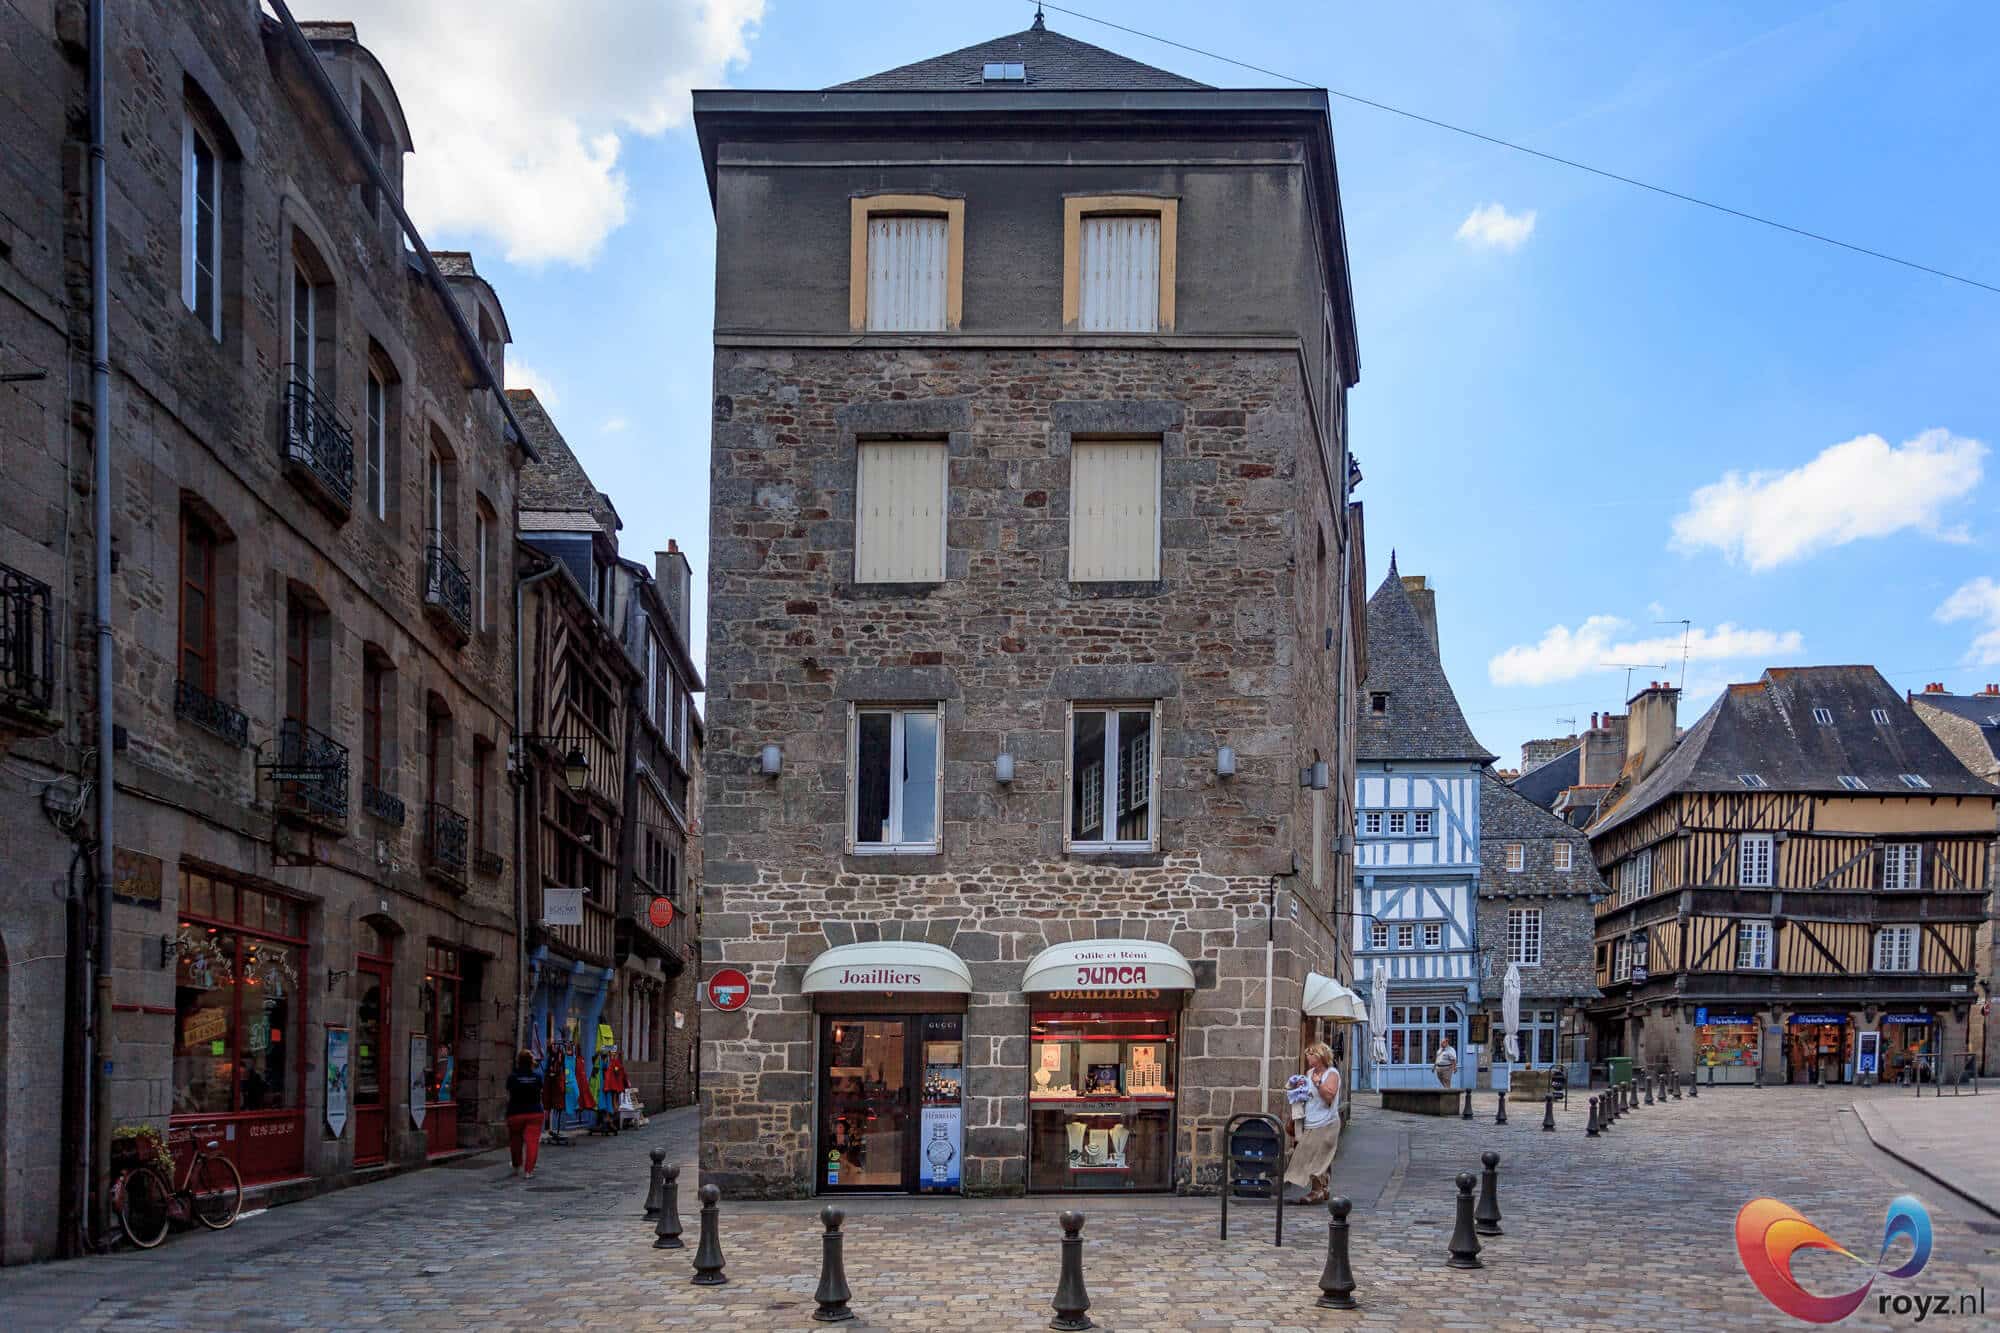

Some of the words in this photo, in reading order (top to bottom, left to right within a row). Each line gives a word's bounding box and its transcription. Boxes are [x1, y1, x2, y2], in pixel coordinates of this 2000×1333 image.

[1074, 952, 1104, 960] Odile
[1121, 951, 1147, 959] Rémi
[839, 968, 921, 985] Joailliers
[1077, 966, 1147, 985] JUNCA
